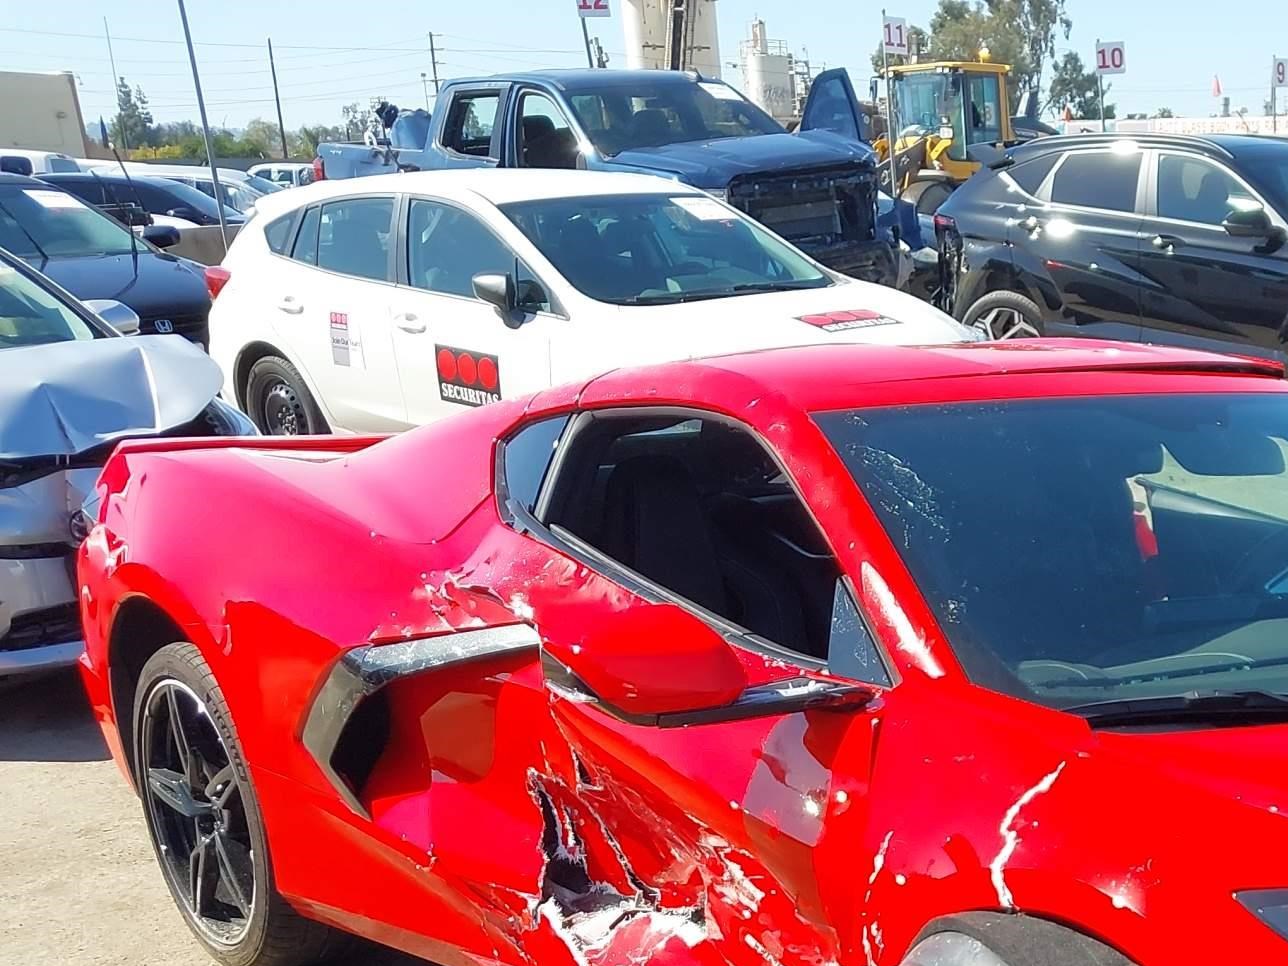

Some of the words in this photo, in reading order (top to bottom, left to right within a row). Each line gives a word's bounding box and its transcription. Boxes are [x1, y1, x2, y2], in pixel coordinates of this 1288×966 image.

[884, 23, 906, 47] 11
[1098, 48, 1123, 69] 10
[1277, 62, 1285, 84] 9
[441, 383, 500, 405] SECURITAS
